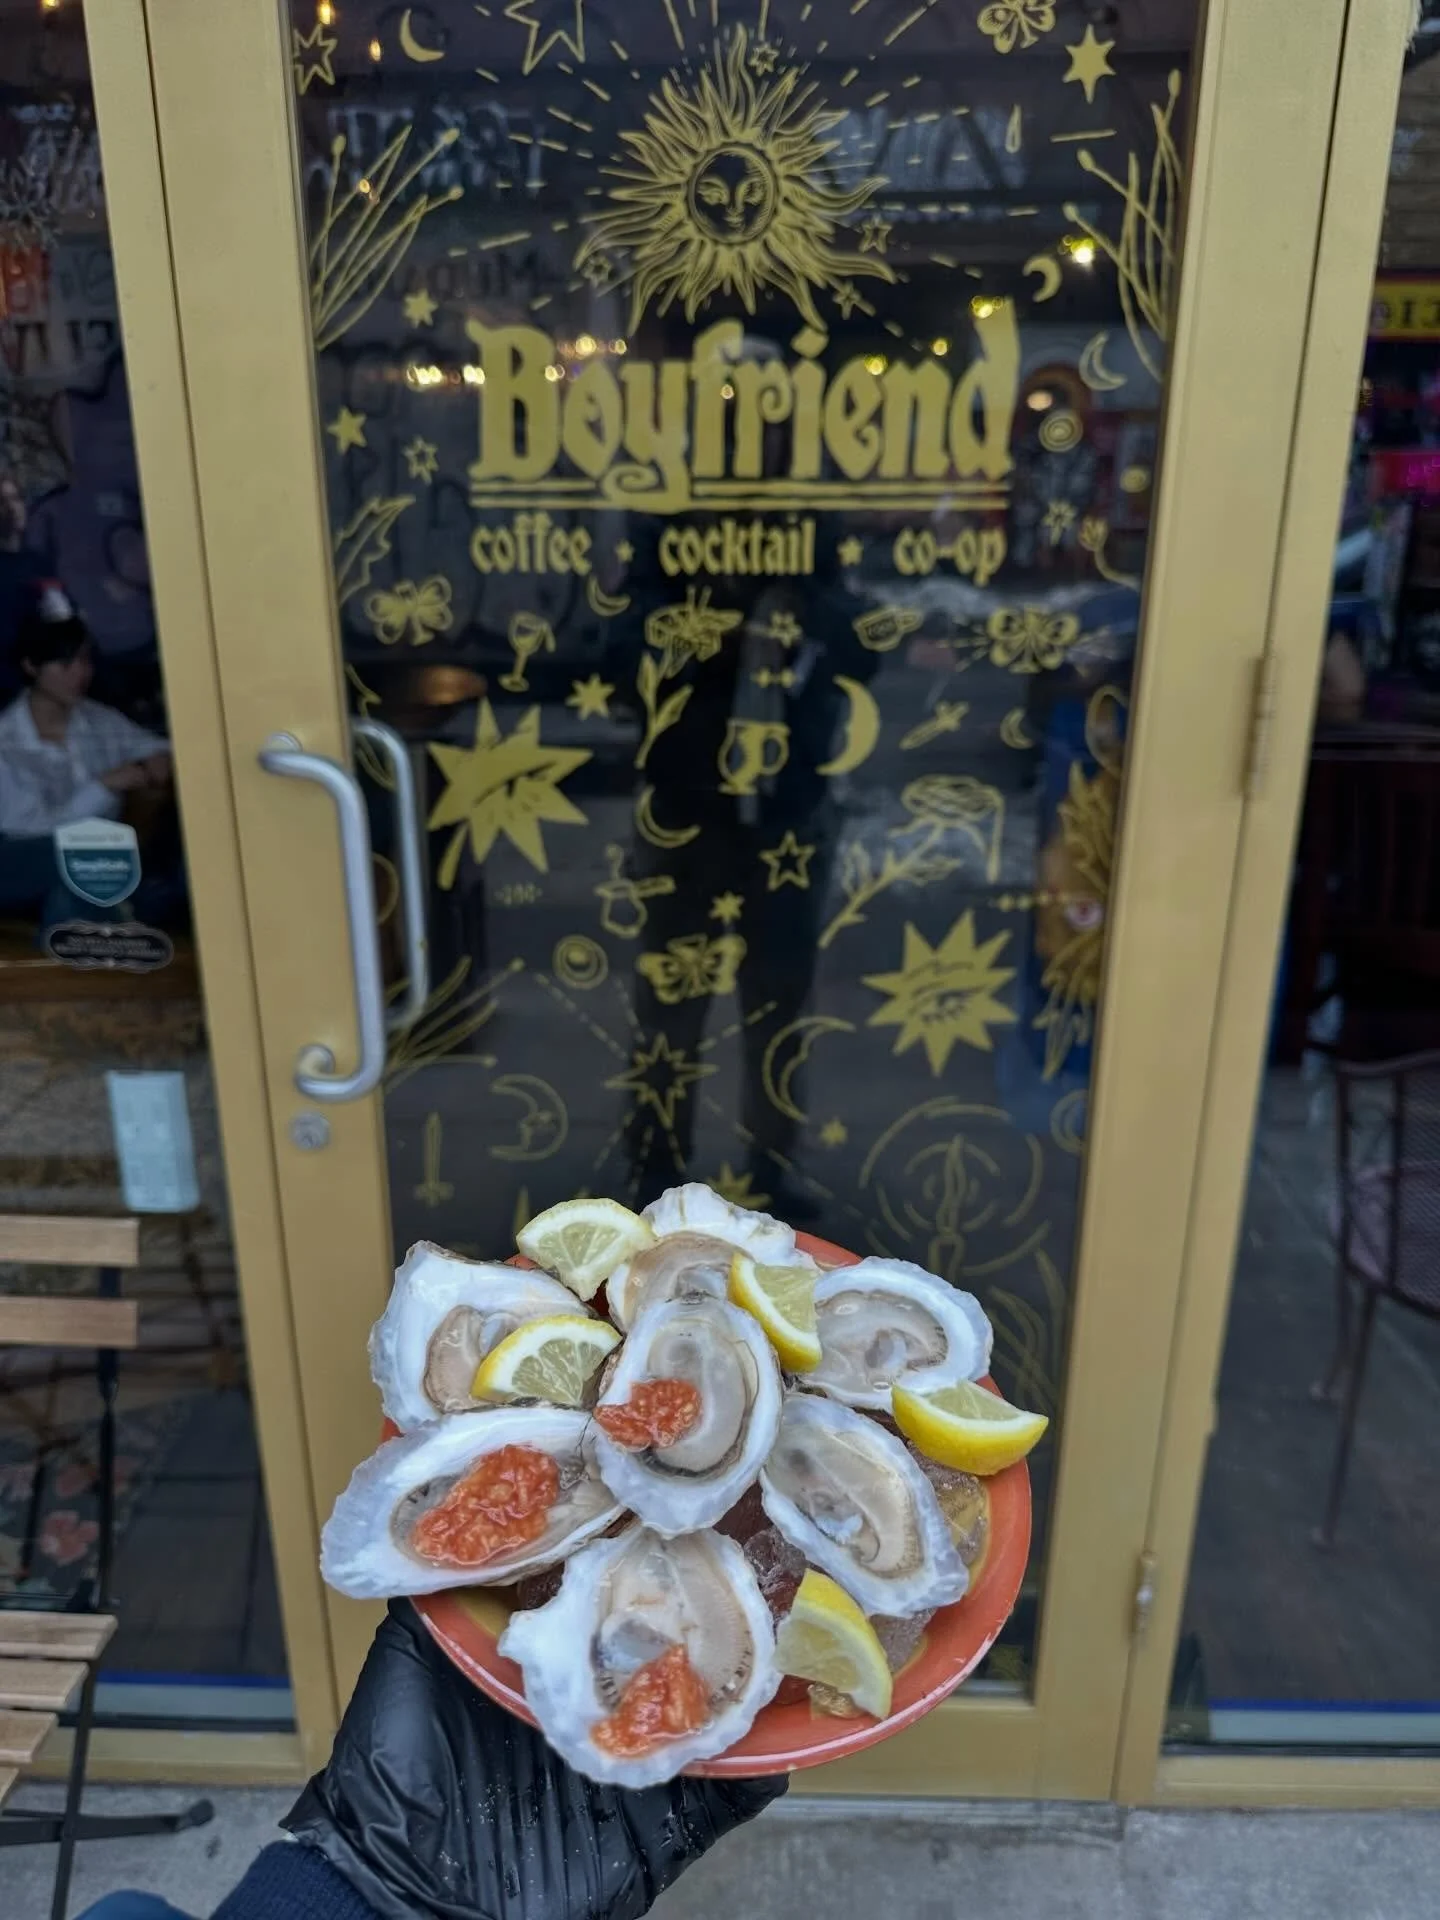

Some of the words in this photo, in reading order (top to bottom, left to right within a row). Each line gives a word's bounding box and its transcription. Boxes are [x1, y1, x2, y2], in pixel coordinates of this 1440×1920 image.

[465, 298, 1019, 514] Boyfriend
[470, 512, 592, 575] coffee
[658, 514, 816, 576] cocktail
[893, 524, 1007, 588] co-op
